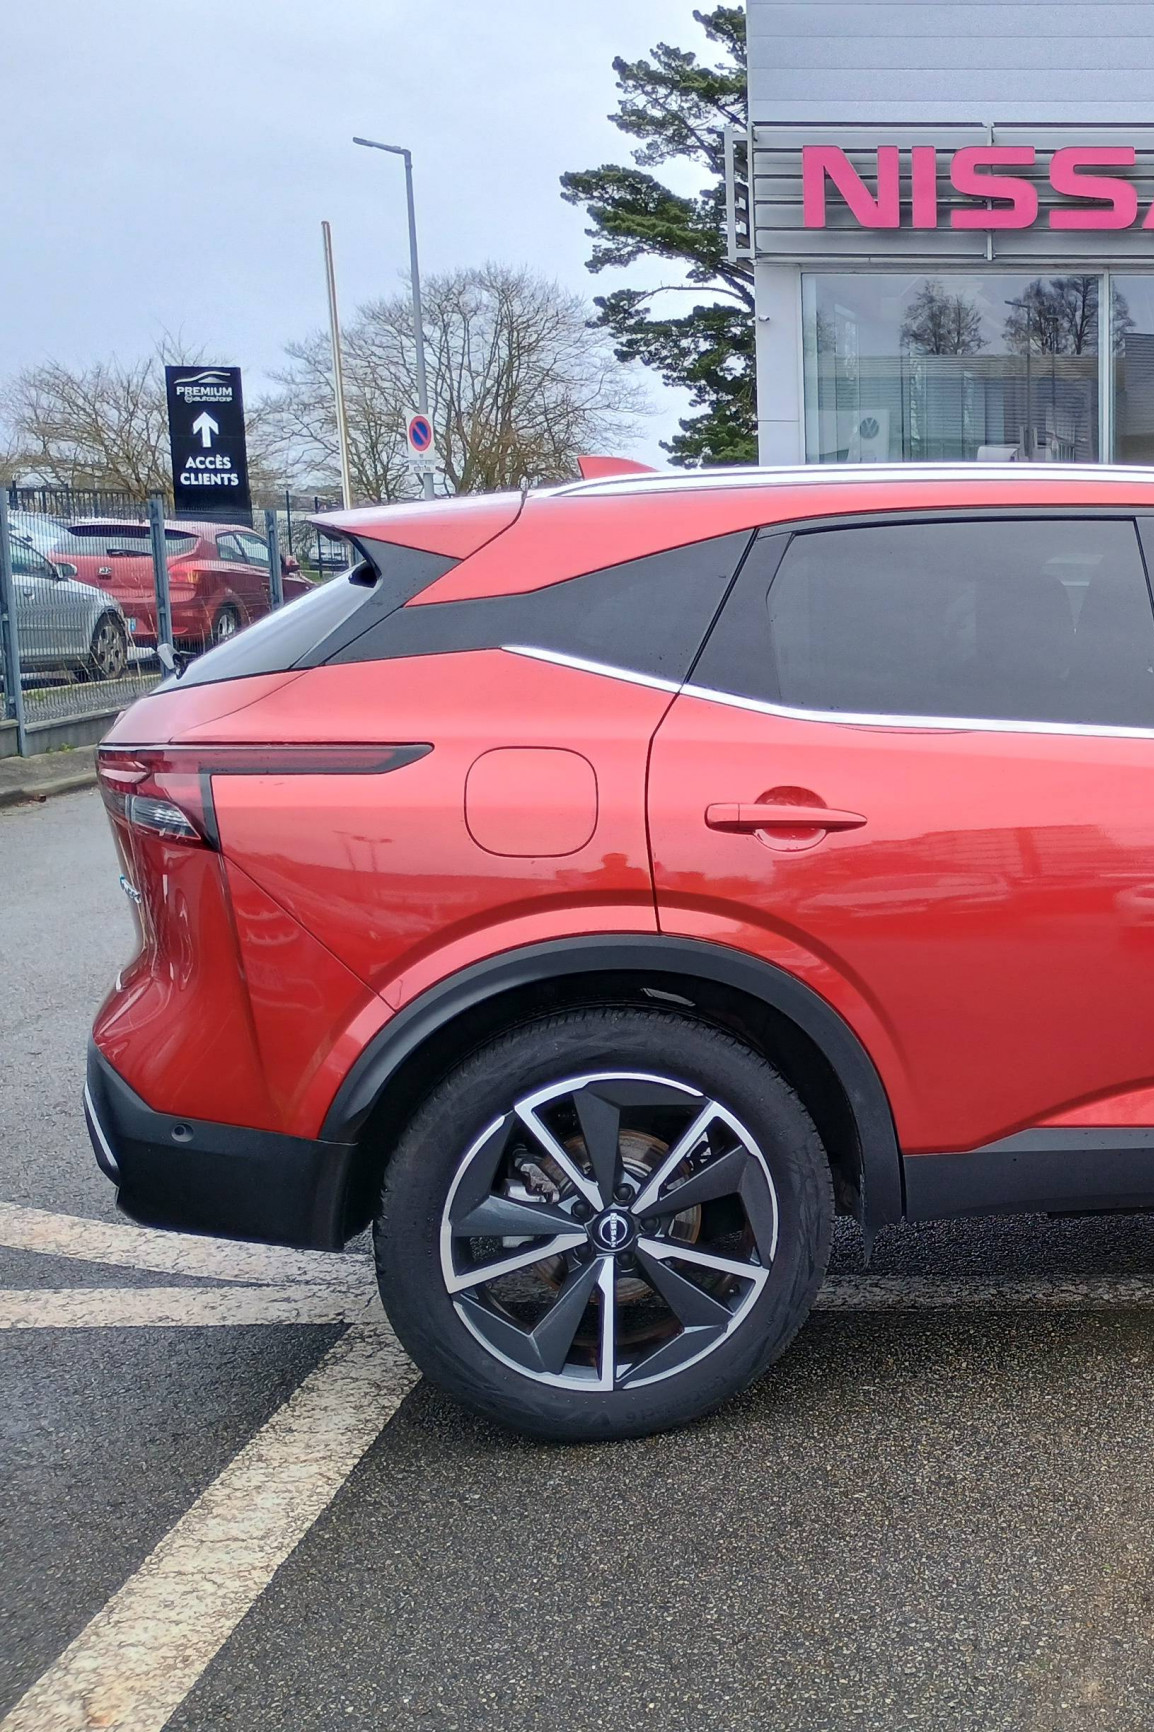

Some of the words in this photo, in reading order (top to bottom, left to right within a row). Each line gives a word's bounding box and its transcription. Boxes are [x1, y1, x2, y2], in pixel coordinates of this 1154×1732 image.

[176, 386, 233, 396] PREMIUM
[185, 454, 232, 469] ACCÈS
[179, 472, 239, 486] CLIENTS
